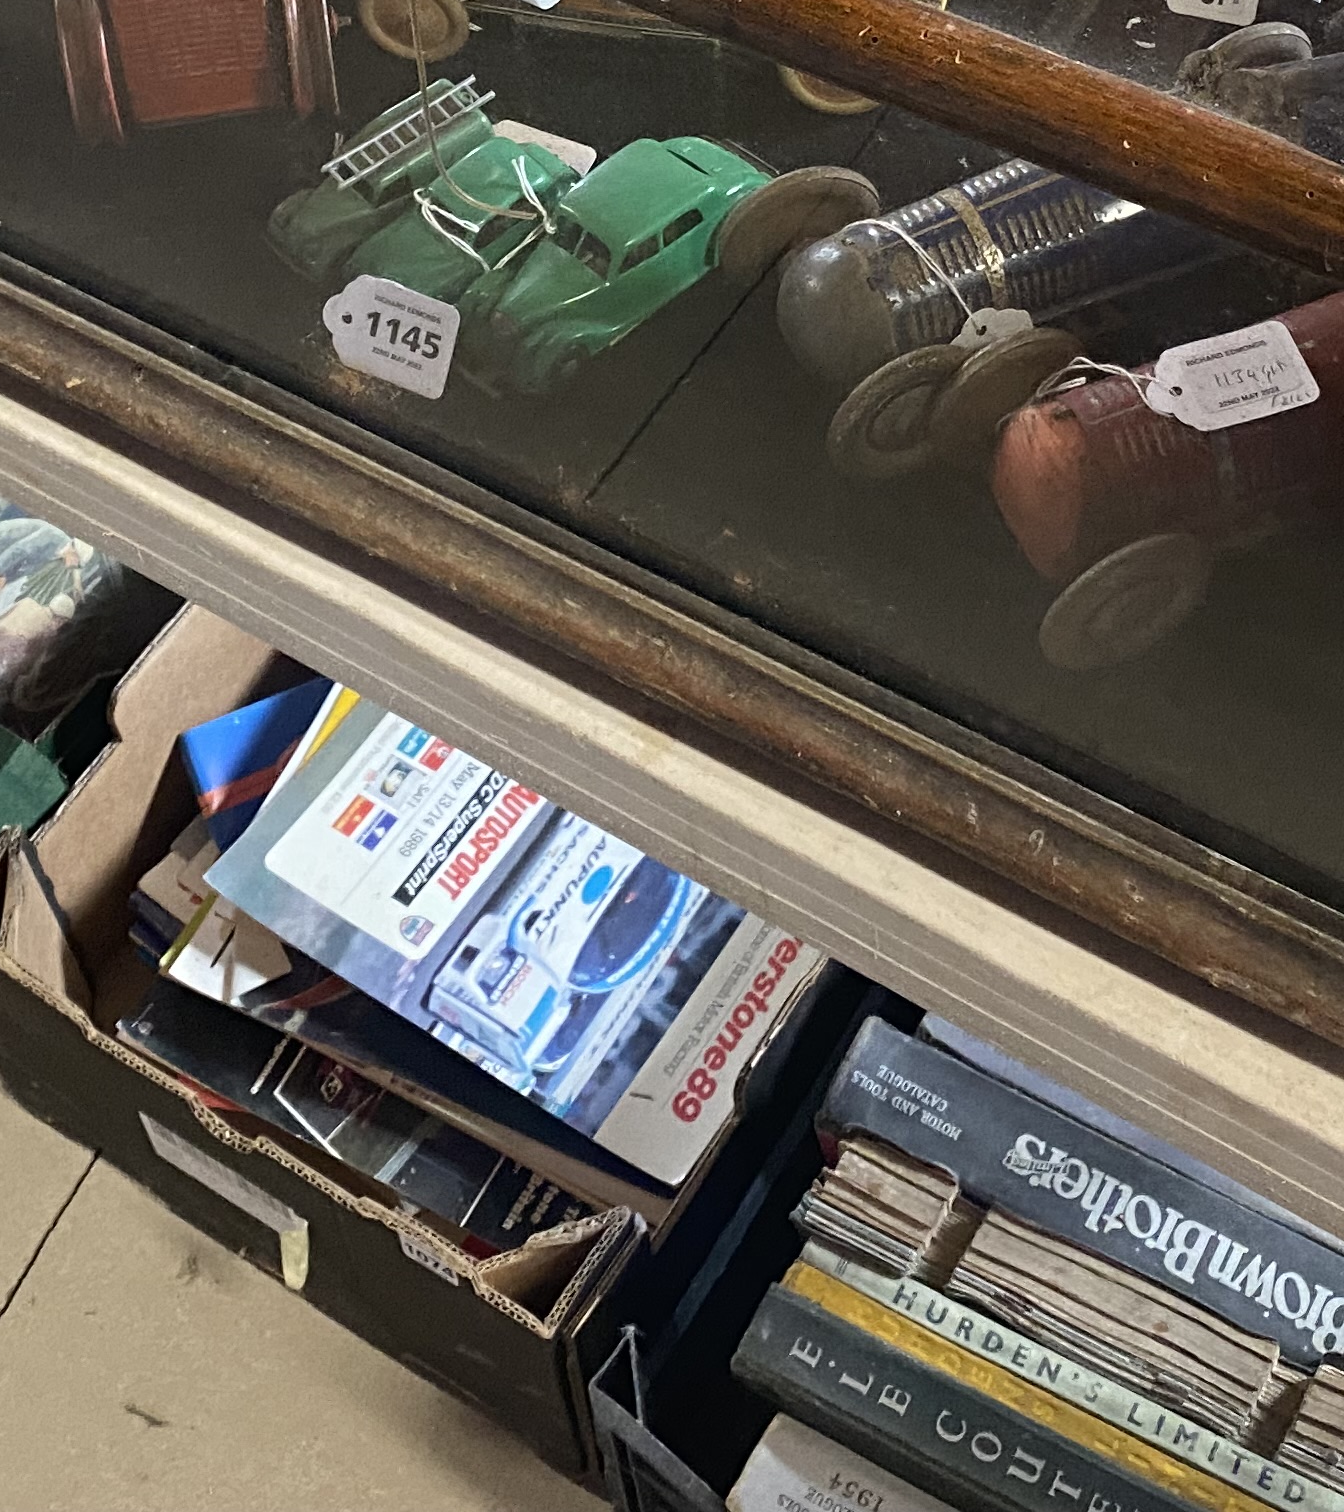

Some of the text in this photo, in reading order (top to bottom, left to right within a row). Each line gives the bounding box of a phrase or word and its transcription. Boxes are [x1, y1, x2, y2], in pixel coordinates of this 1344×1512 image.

[367, 311, 442, 360] 1145
[398, 761, 481, 859] May 13/14 1989
[436, 784, 541, 902] AUTOSPORT
[671, 936, 805, 1124] erstone89
[698, 1000, 725, 1034] Motor
[663, 1034, 701, 1078] Racing
[850, 1069, 963, 1142] MOTOR AND TOOLS
[875, 1063, 949, 1114] CATALOGUE
[892, 1283, 1105, 1405] HURDEN'S
[1127, 1401, 1308, 1506] LIMITED
[828, 1472, 887, 1512] 1954
